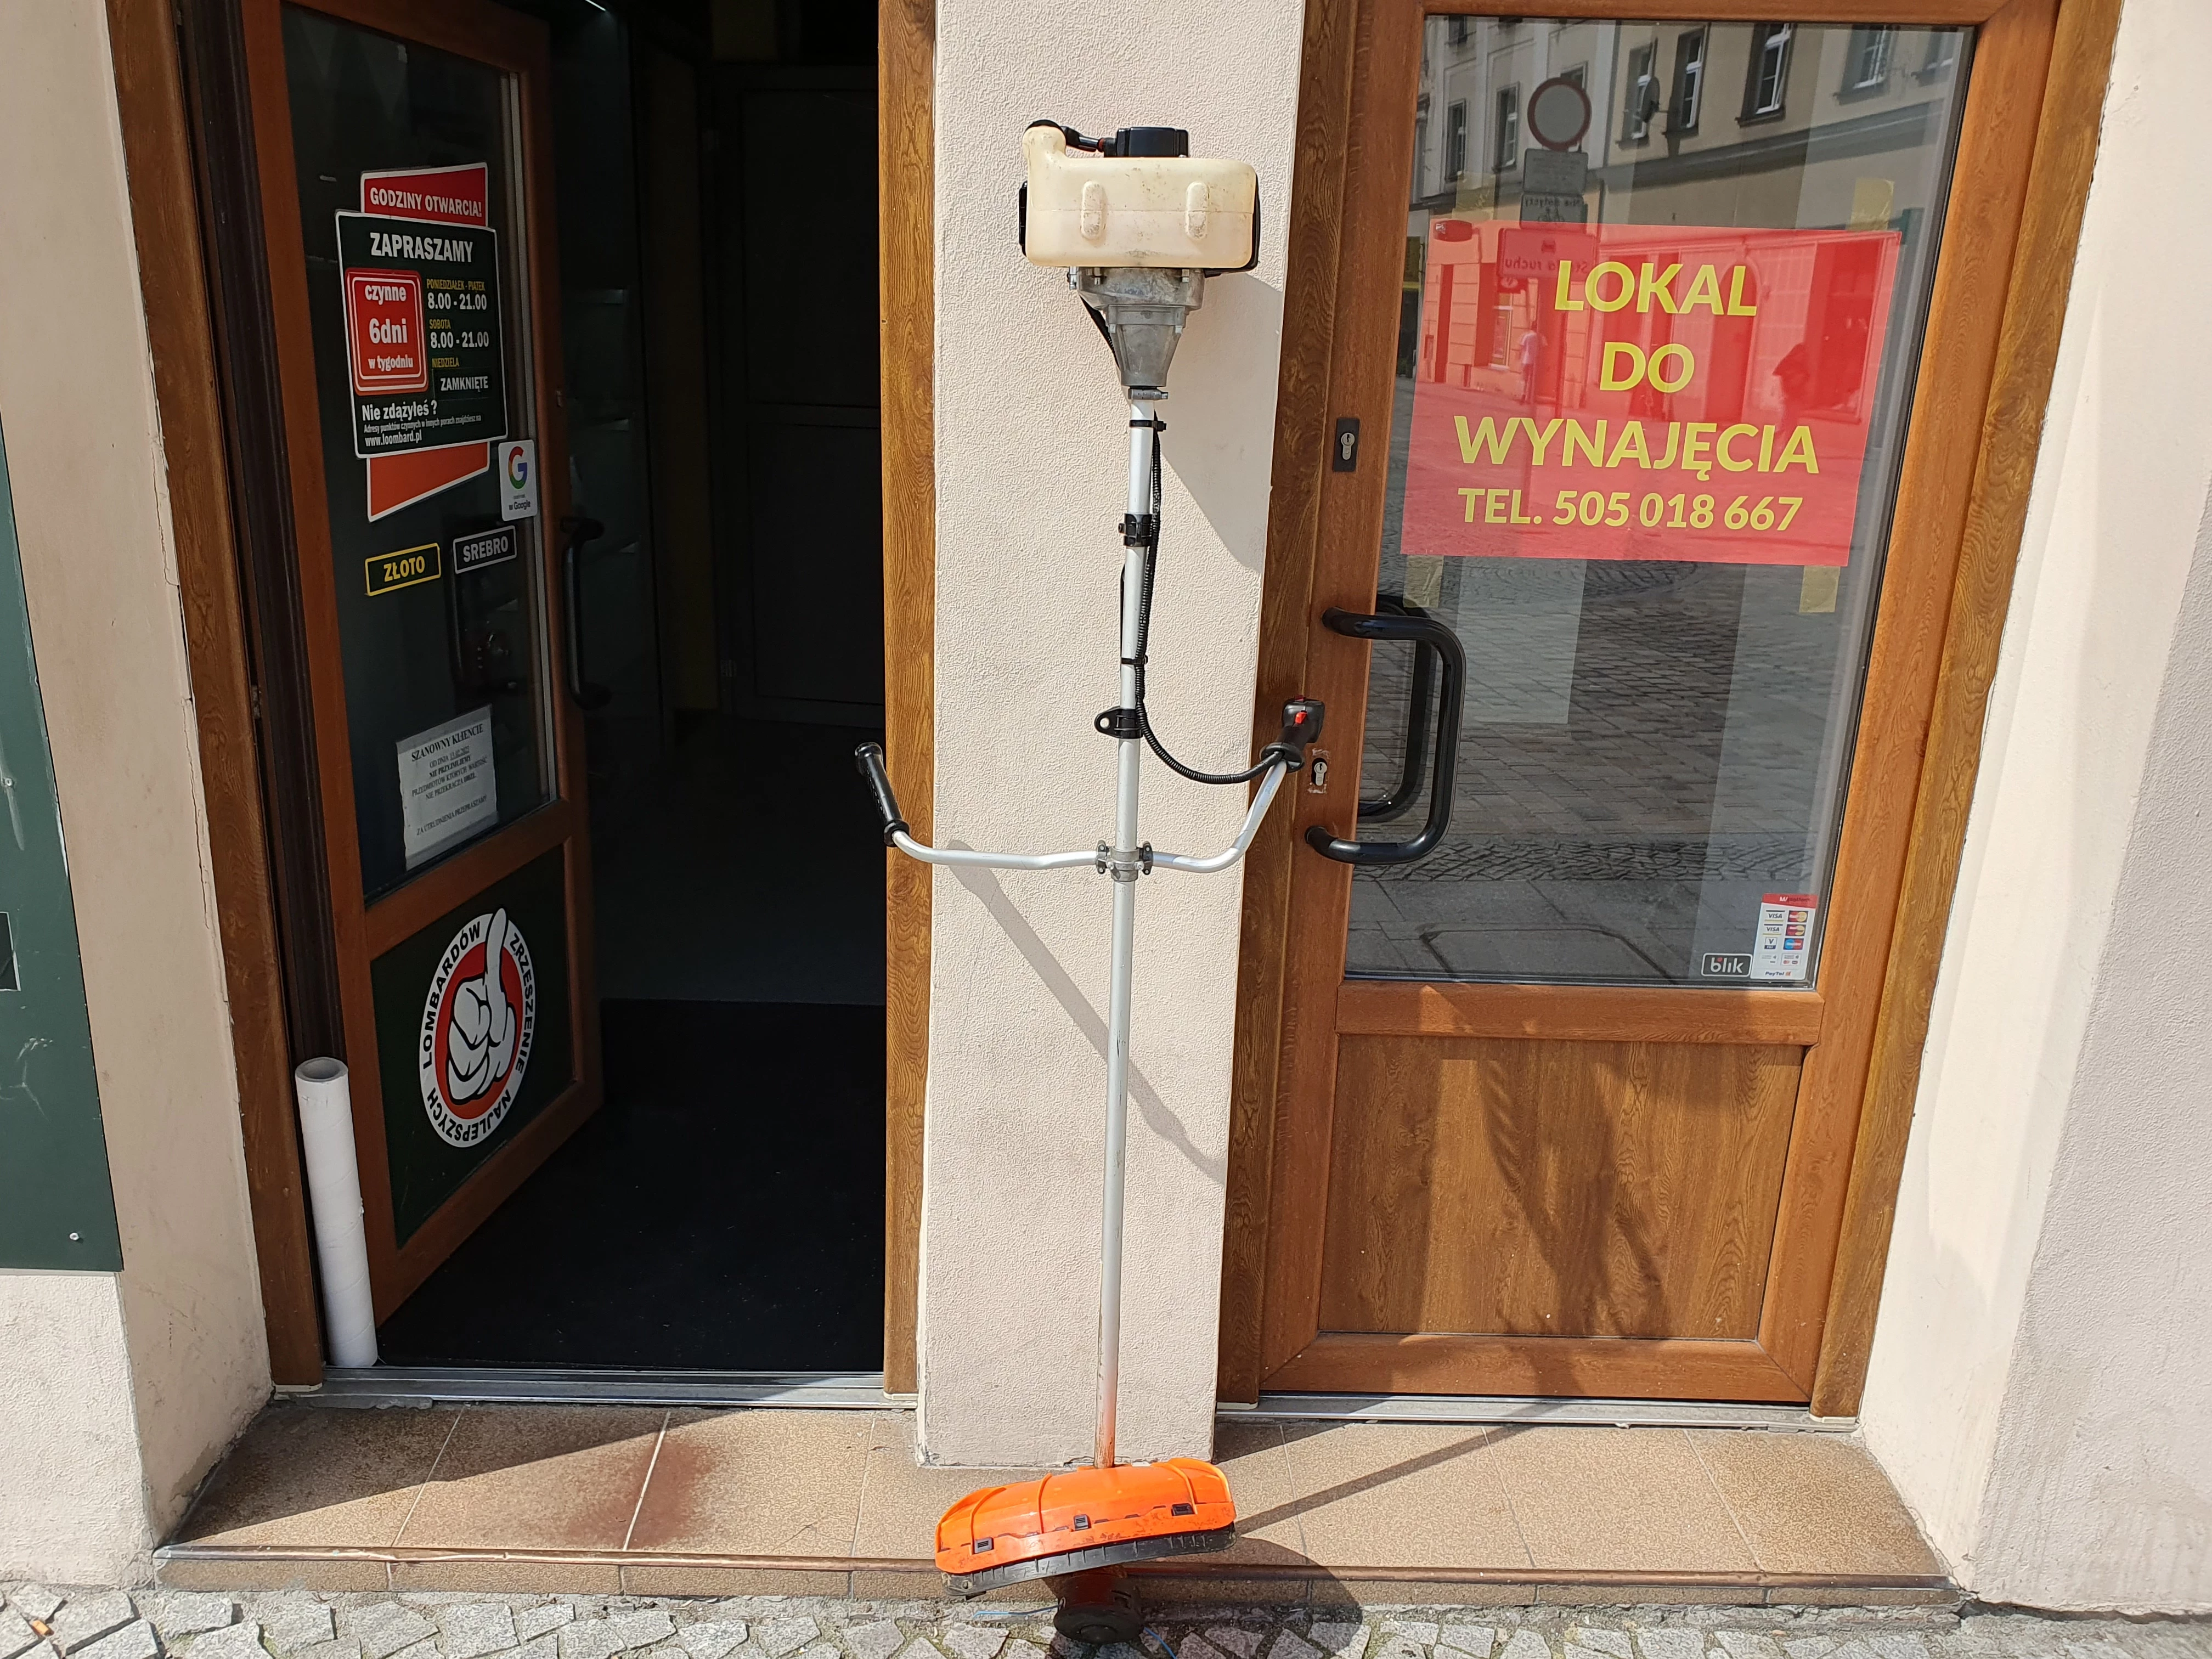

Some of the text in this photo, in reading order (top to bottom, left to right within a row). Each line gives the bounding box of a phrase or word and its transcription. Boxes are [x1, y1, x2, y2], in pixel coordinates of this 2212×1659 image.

[370, 187, 482, 217] GODZINY OTWARCIA!
[370, 232, 473, 262] ZAPRASZAMY
[365, 285, 407, 305] czynne
[426, 279, 465, 290] PONIEDZIAŁEK
[468, 280, 485, 292] PIĄTEK
[1554, 259, 1757, 317] LOKAL
[427, 292, 451, 309] 8.00
[459, 294, 487, 310] 21.00
[369, 318, 408, 343] 6dni
[429, 319, 451, 329] SOBOTA
[430, 331, 454, 348] 8.00
[461, 331, 489, 347] 21.00
[368, 354, 413, 372] w tygodniu
[432, 357, 459, 368] NIEDZIELA
[1599, 341, 1695, 394] DO
[440, 376, 489, 392] ZAMKNIĘTE
[362, 399, 437, 421] Nie zdążyłeś ?
[364, 424, 380, 434] Adresy
[365, 430, 422, 447] www.loombard.pl
[1454, 415, 1819, 481] WYNAJĘCIA
[514, 500, 531, 510] Google
[1458, 488, 1803, 532] TEL. 505 018 667
[463, 536, 509, 562] SREBRO
[383, 556, 425, 582] ZŁOTO
[411, 737, 451, 762] SZANOWNY
[452, 723, 483, 745] KLIENCIE
[1710, 957, 1744, 973] blik
[423, 921, 534, 1142] ZRZESZENIE NAJLEPSZYCH LOMBARDÓW
